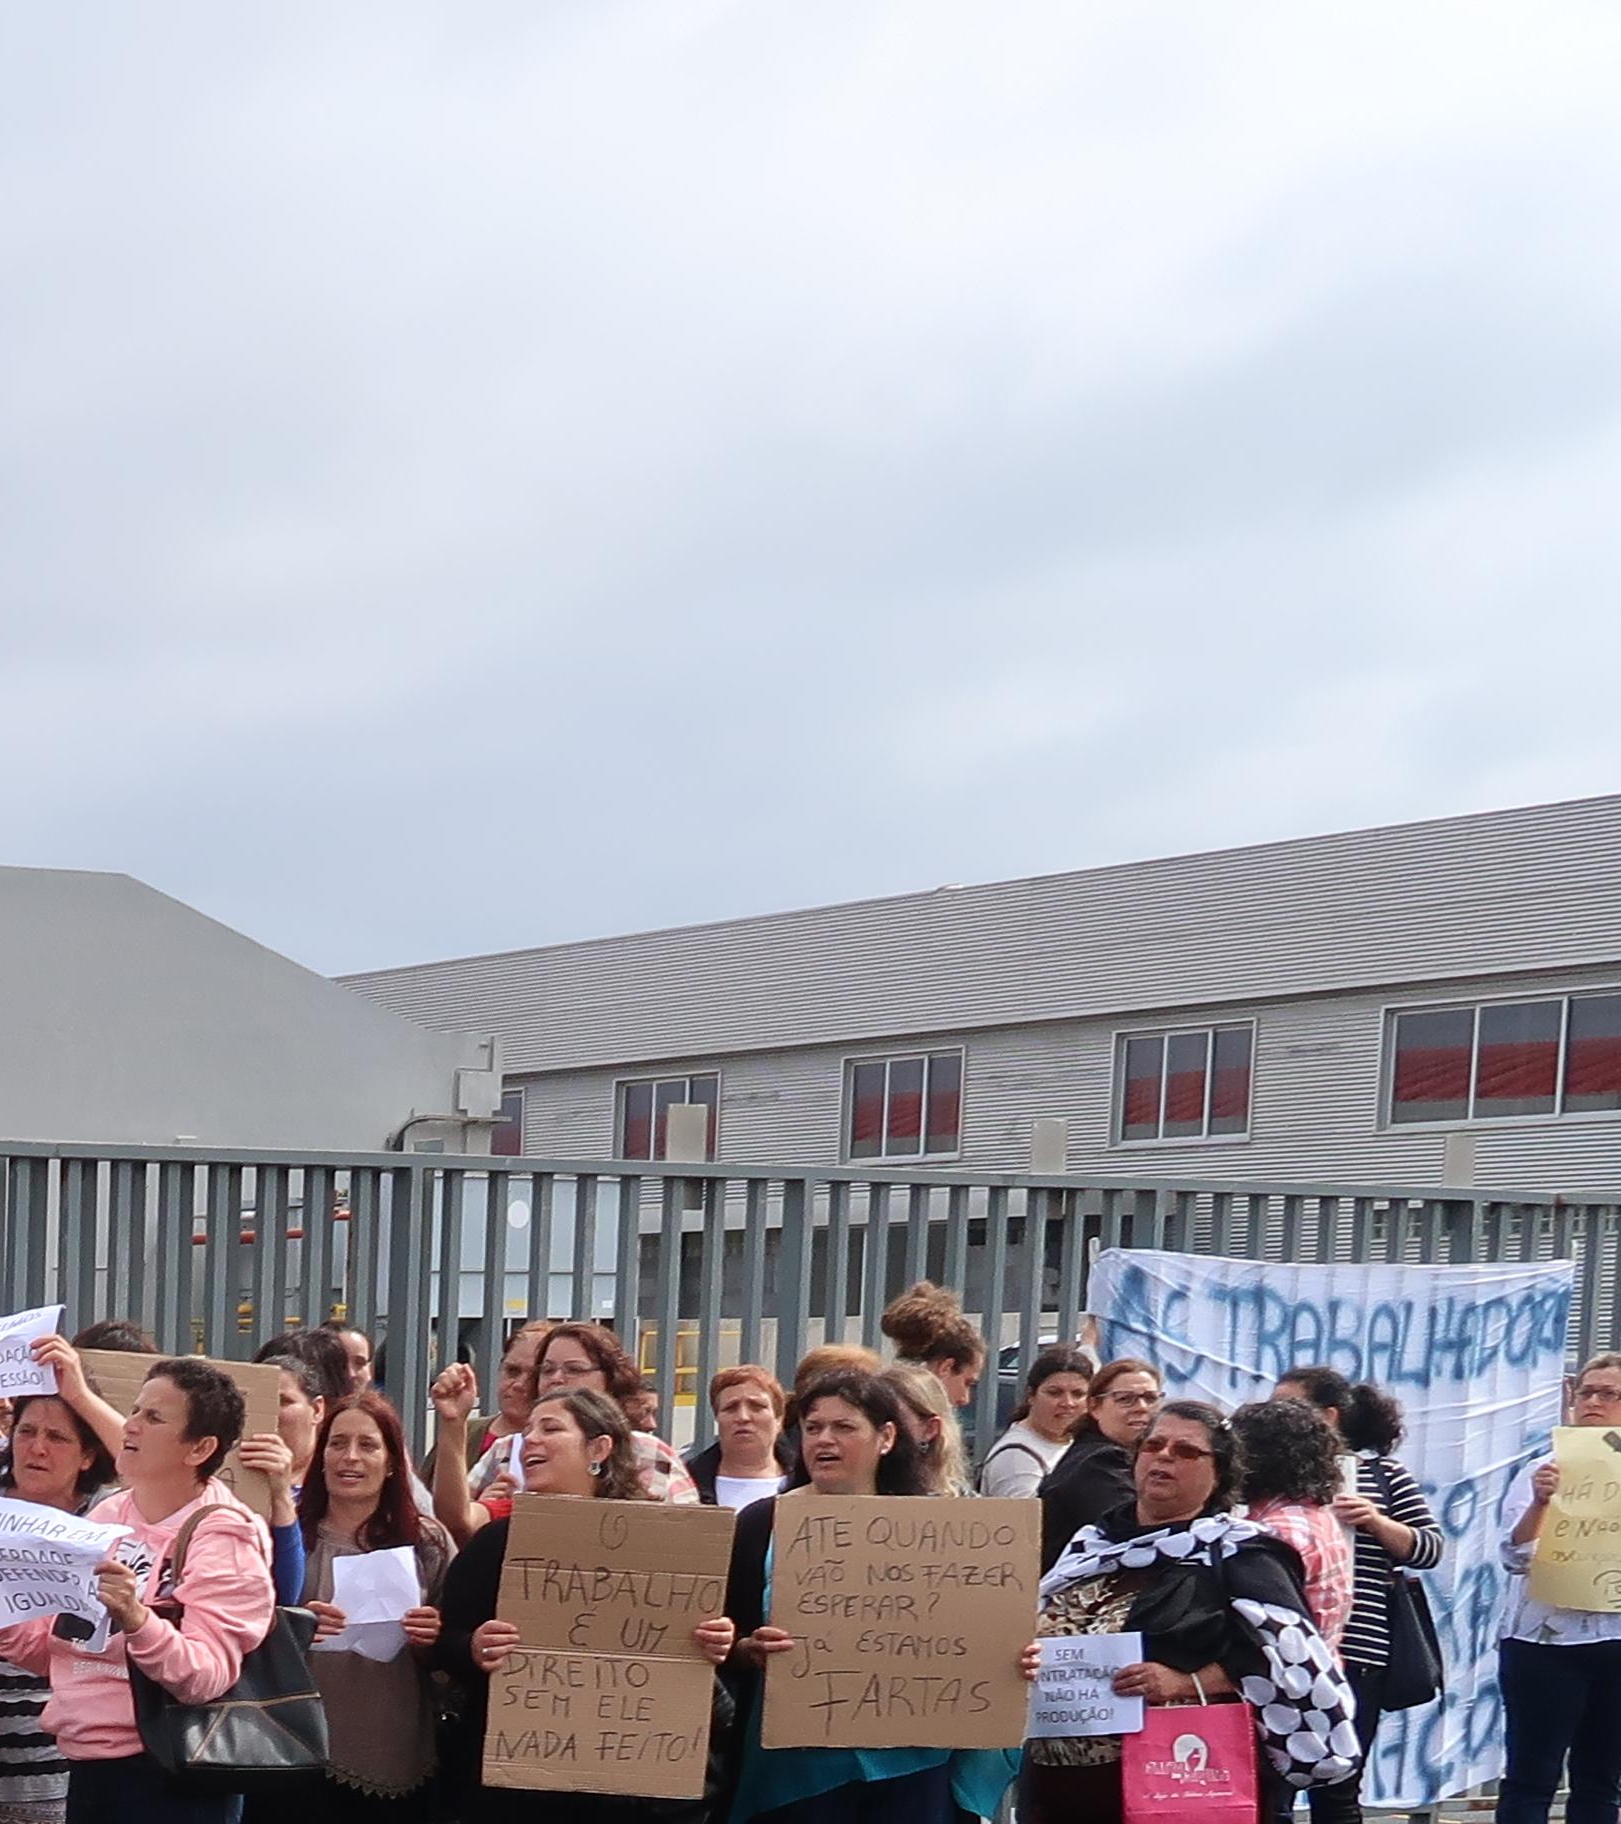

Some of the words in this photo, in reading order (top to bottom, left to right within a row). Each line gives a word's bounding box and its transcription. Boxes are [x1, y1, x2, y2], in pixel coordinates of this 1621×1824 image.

[786, 1504, 856, 1559] ATÉ
[866, 1516, 1015, 1552] QUANDO
[87, 1580, 98, 1600] A
[510, 1557, 723, 1613] TRABALHO
[867, 1564, 914, 1586] NOS
[921, 1563, 1023, 1591] FAZER
[568, 1607, 598, 1646] É
[621, 1618, 668, 1650] UM
[857, 1630, 968, 1660] ESTAMOS
[1055, 1648, 1084, 1660] SEM
[1040, 1665, 1120, 1682] NTRATAÇÃO
[503, 1686, 571, 1719] SEM
[598, 1695, 656, 1722] ELE
[809, 1671, 991, 1736] FARTAS
[1044, 1687, 1075, 1702] NÃO
[1036, 1706, 1115, 1725] PRODUÇÃO!
[495, 1730, 577, 1762] NADA
[595, 1727, 704, 1762] FEITO!
